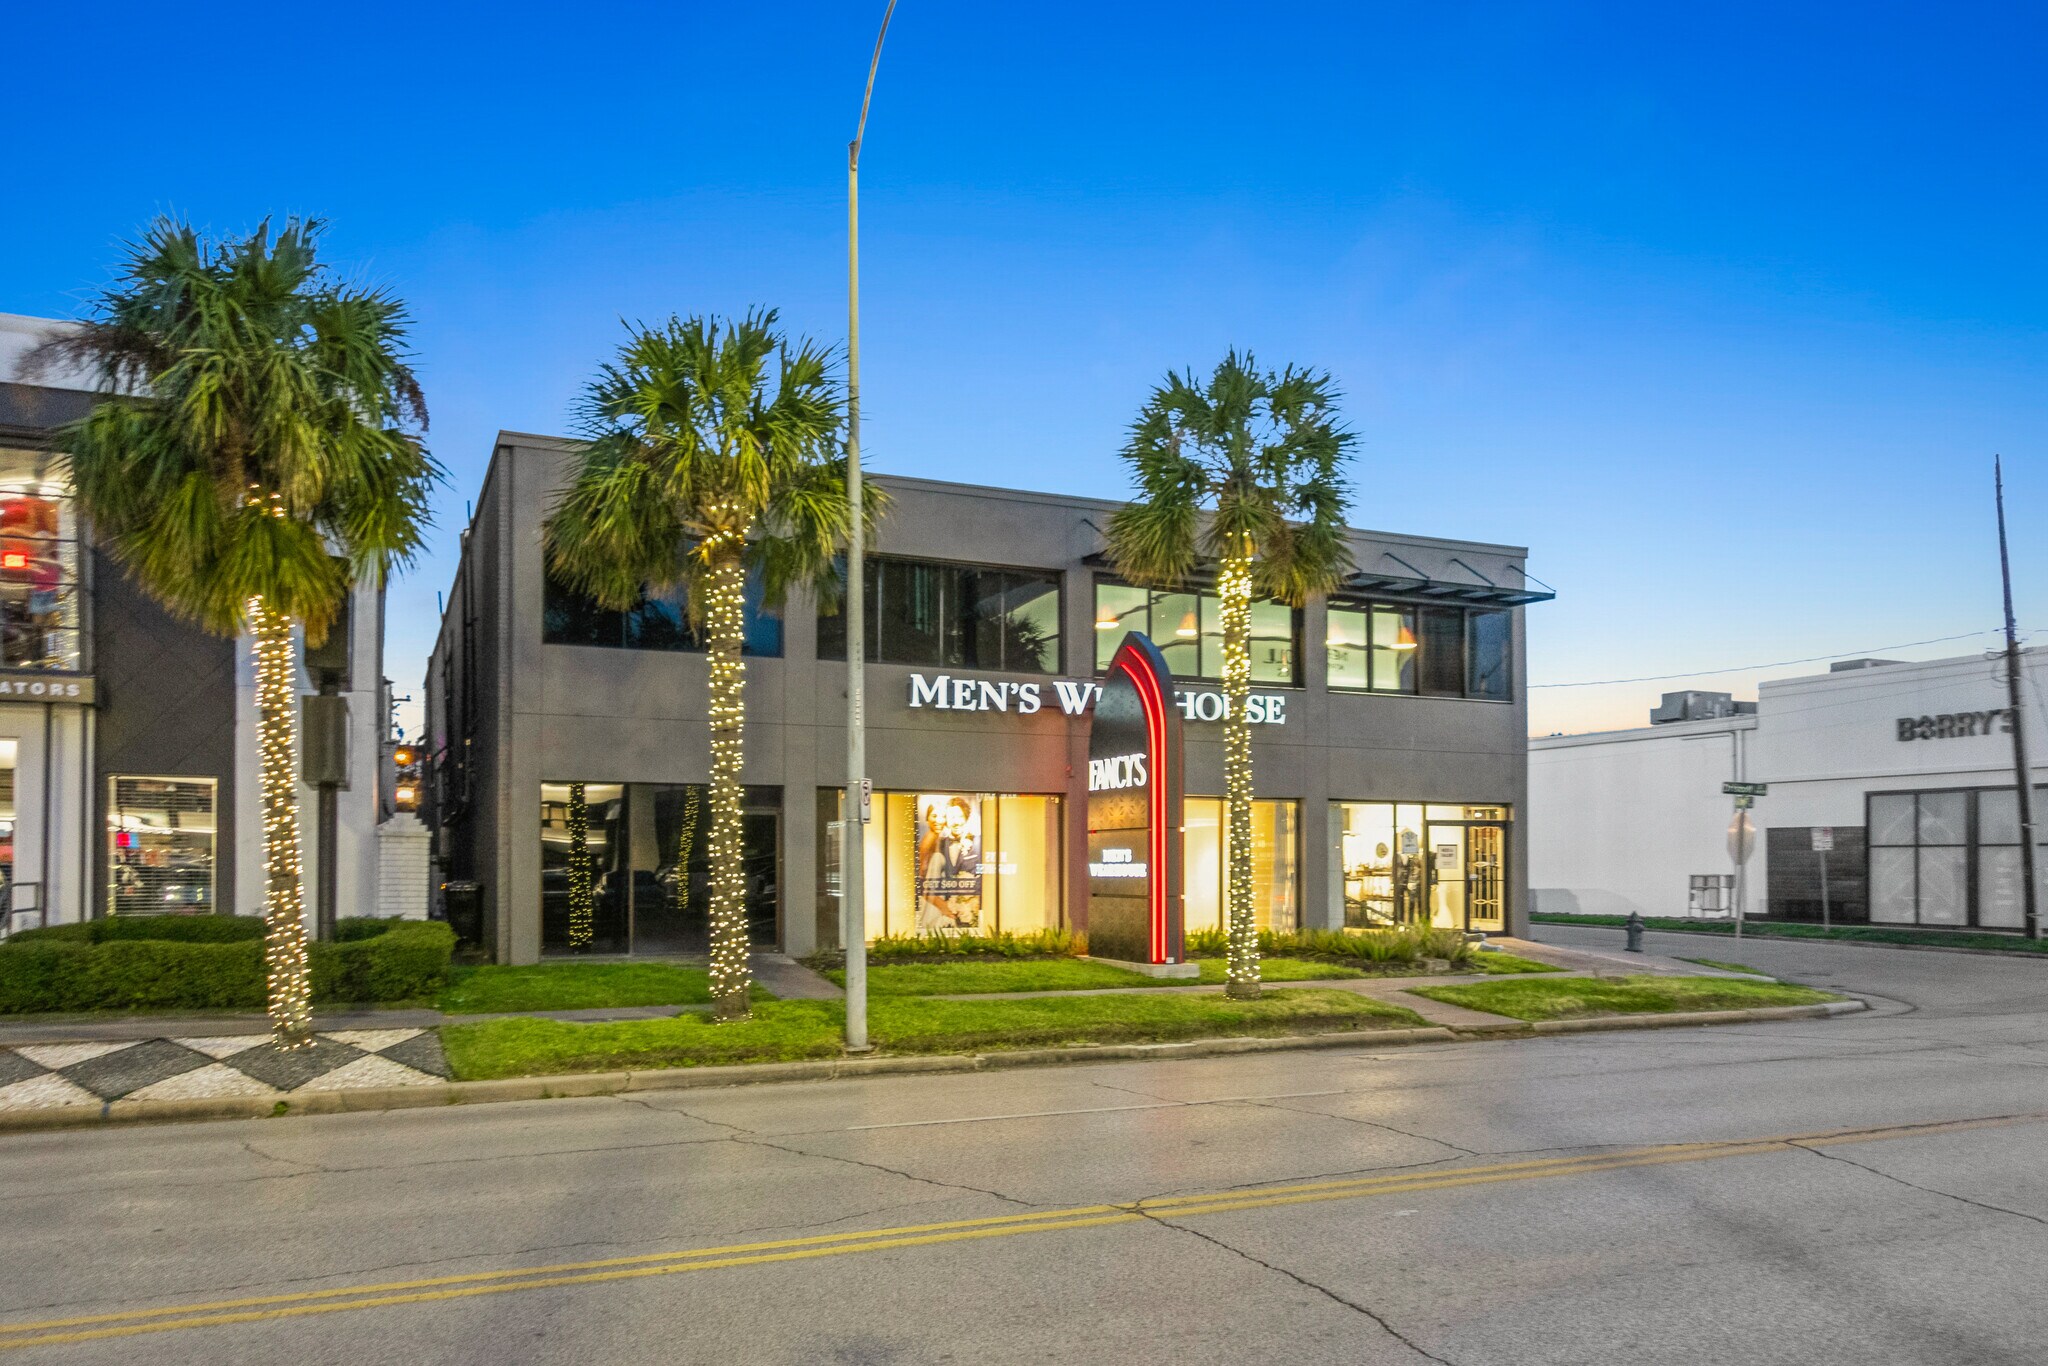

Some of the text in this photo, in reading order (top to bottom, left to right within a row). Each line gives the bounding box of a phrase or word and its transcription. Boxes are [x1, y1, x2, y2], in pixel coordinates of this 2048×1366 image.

[0, 681, 80, 697] ATORS
[909, 673, 1041, 714] MEN'S
[1052, 681, 1286, 725] WHOSE
[958, 880, 977, 889] OFF
